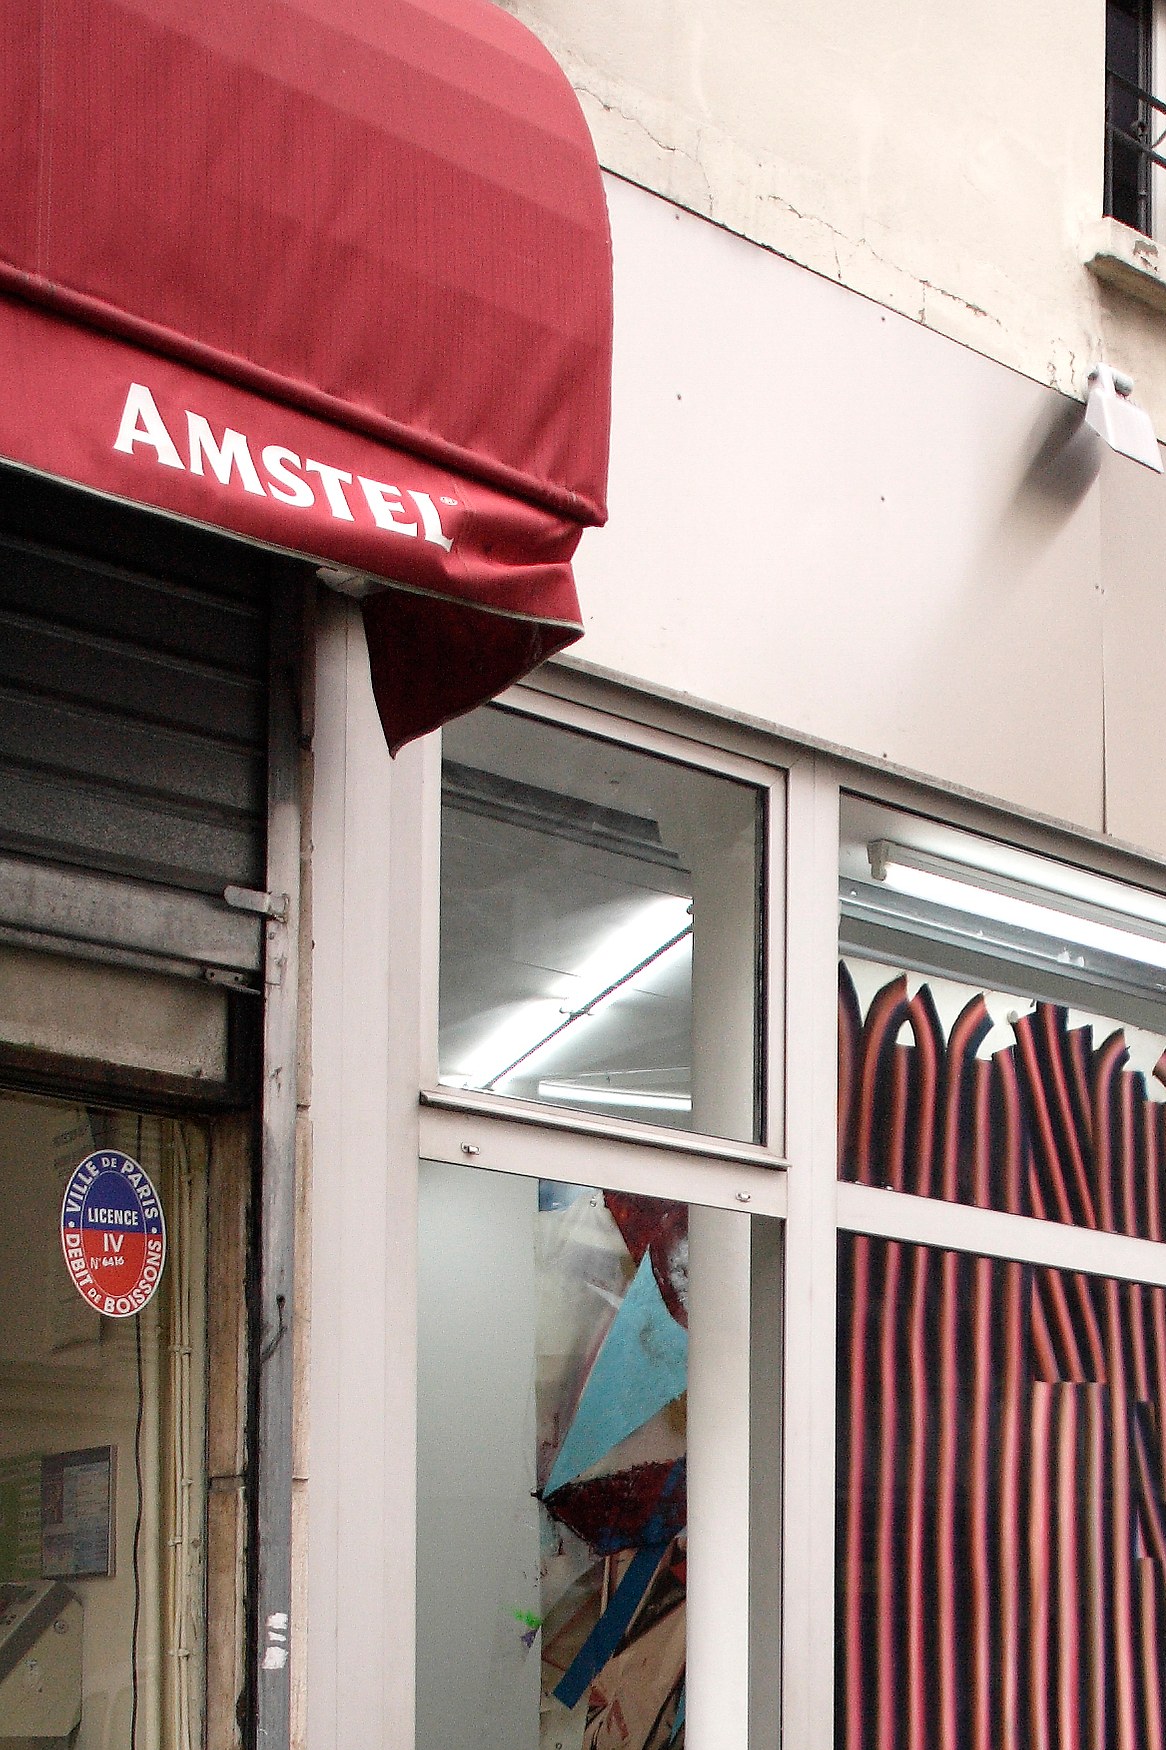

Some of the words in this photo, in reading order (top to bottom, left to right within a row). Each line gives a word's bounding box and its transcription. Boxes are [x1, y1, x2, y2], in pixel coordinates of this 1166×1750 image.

[113, 382, 455, 552] AMSTEL
[66, 1161, 100, 1213] VILLE
[101, 1157, 117, 1168] DE
[121, 1160, 158, 1219] PARIS
[88, 1207, 139, 1226] LICENCE
[66, 1233, 94, 1287] DEBIT
[87, 1288, 102, 1304] DE
[104, 1239, 162, 1314] BOISSONS
[103, 1232, 124, 1253] IV
